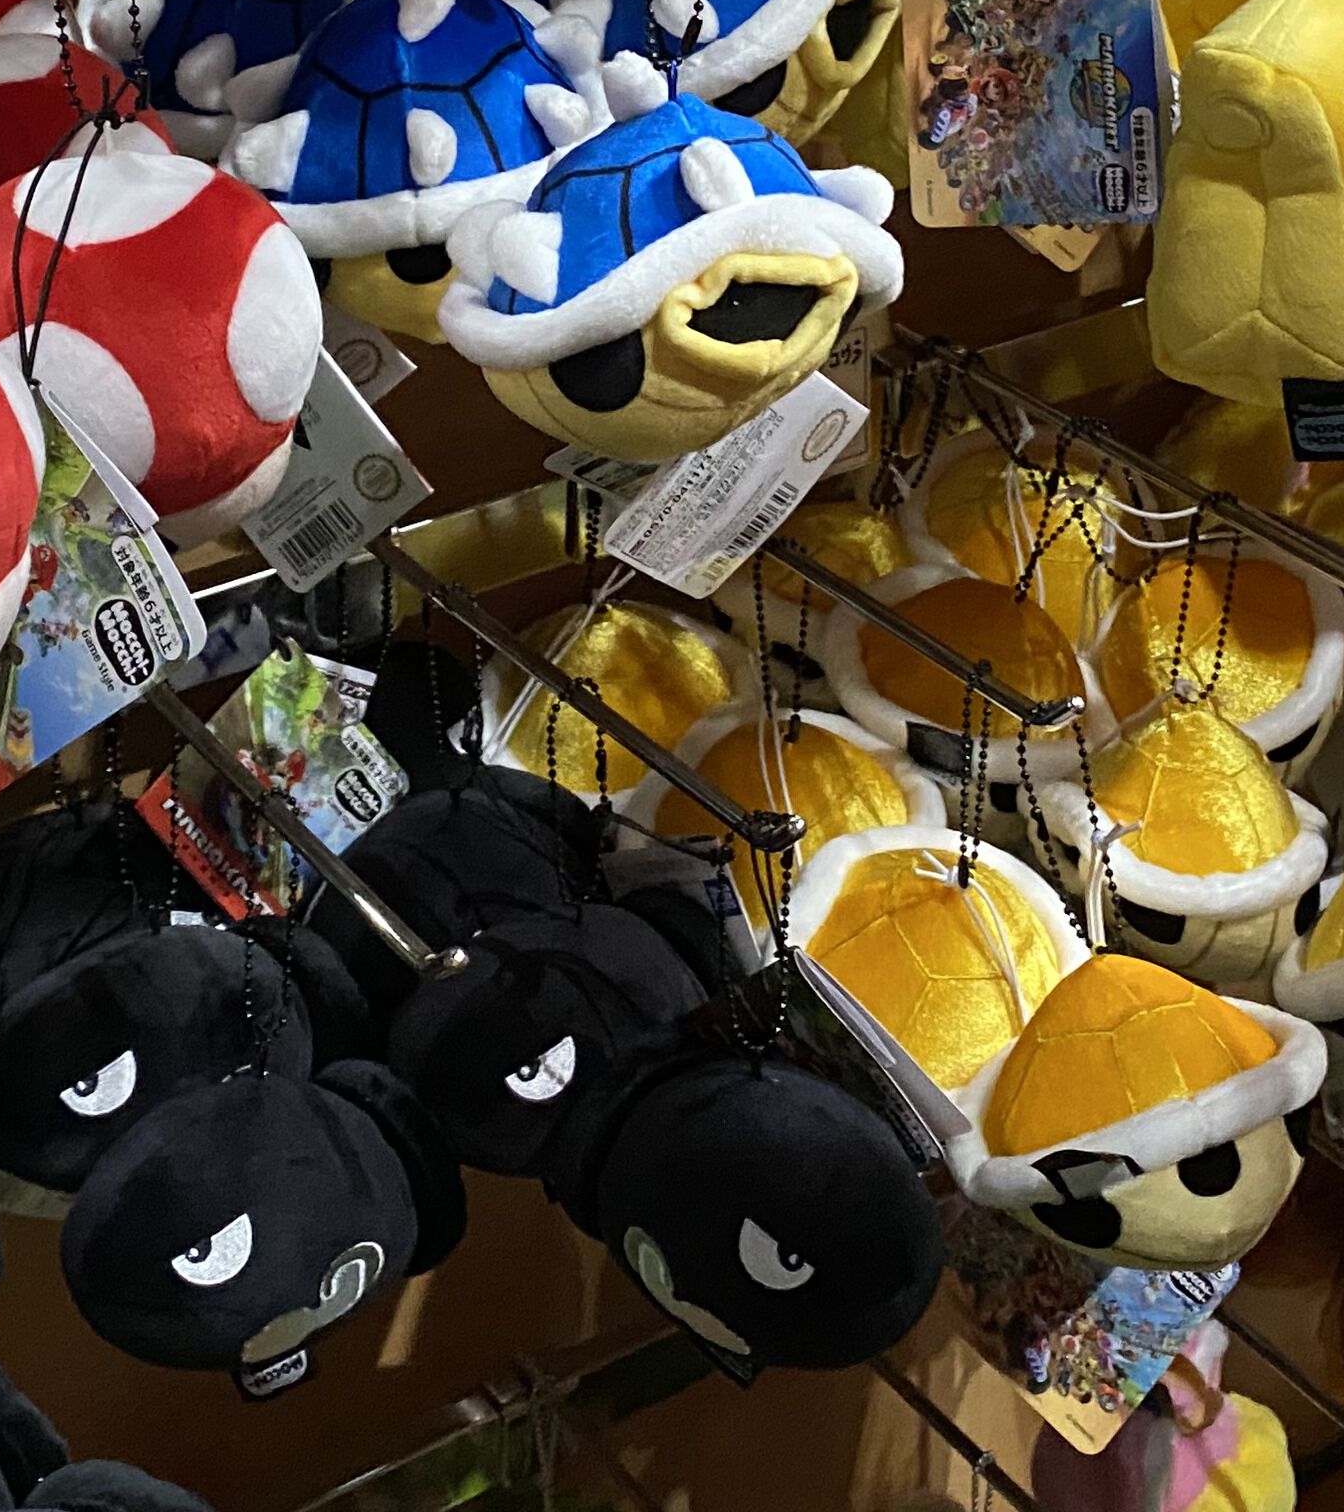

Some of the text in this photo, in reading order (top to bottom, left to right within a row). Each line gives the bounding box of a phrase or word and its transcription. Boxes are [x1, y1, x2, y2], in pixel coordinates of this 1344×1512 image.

[110, 545, 179, 655] 対象年齢6才以上
[110, 599, 156, 678] Mocchi-
[78, 628, 119, 693] Game Style
[95, 608, 144, 686] Mocchi-
